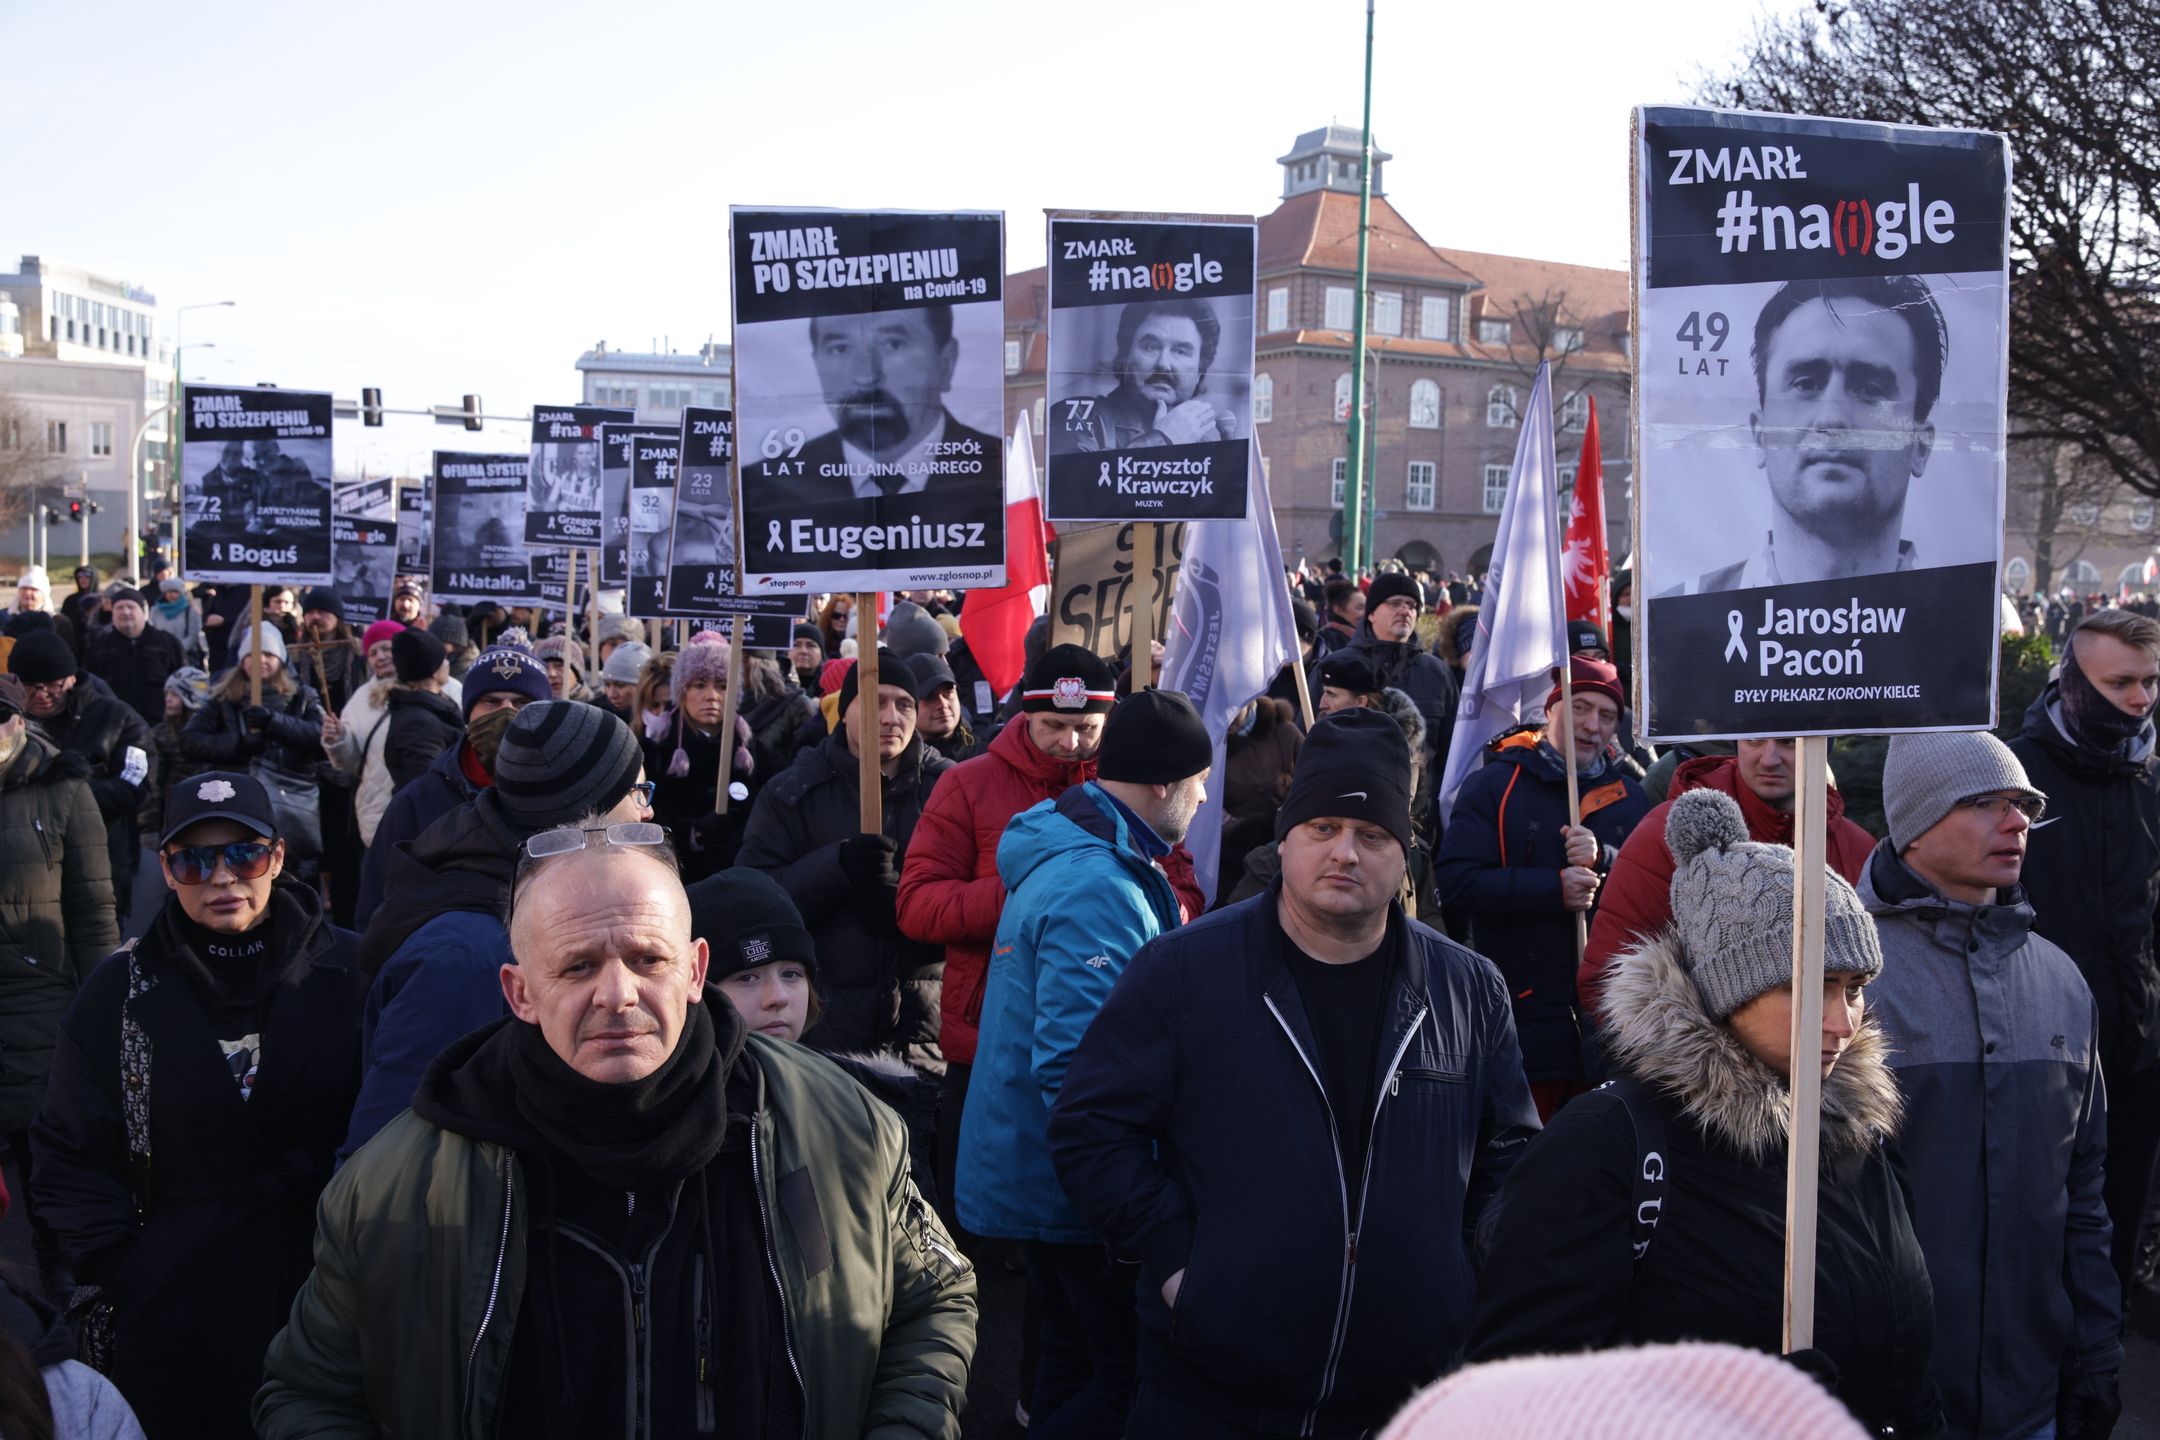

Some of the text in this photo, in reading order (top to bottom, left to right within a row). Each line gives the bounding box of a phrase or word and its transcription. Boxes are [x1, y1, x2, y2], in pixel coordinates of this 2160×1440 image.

[1667, 144, 1808, 186] ZMARŁ
[1715, 182, 1956, 260] #na(i)gle
[749, 226, 840, 262] ZMARŁ
[1063, 237, 1137, 260] ZMARŁ
[752, 247, 960, 295] PO SZCZEPIENIU
[1088, 253, 1224, 293] #na(i)gle
[903, 277, 987, 301] na Covid-19
[1675, 311, 1731, 352] 49
[1678, 357, 1730, 376] LAT
[193, 396, 243, 412] ZMARŁ
[1065, 400, 1095, 421] 77
[194, 410, 310, 429] PO SZCZEPIENIU
[538, 412, 576, 423] ZMARŁ
[289, 426, 326, 437] Covid-19
[1065, 422, 1095, 431] LAT
[760, 428, 806, 459] 69
[924, 439, 983, 457] ZESPÓŁ
[640, 448, 678, 460] ZMAR
[441, 463, 486, 479] OFIARA
[762, 462, 806, 477] LAT
[819, 459, 983, 478] GUILLAINA BARREGO
[1117, 456, 1212, 479] Krzysztof
[691, 473, 713, 488] 23
[1117, 475, 1213, 498] Krawczyk
[197, 497, 221, 514] 72
[642, 496, 660, 507] 32
[1135, 499, 1163, 508] MUZYK
[256, 506, 321, 517] ZATRZYMANIE
[275, 517, 322, 527] KRĄŻENIA
[563, 525, 594, 536] Olech
[612, 517, 628, 529] 19
[791, 515, 986, 559] Eugeniusz
[229, 543, 298, 567] Boguś
[460, 573, 526, 590] Natalka
[770, 579, 806, 588] stopnop
[909, 569, 993, 584] www.zglosnop.pl
[1757, 597, 1907, 636] Jarosław
[1759, 638, 1864, 677] Pacoń
[1734, 684, 1921, 703] BYŁY PIŁKARZ KORONY KIELCE
[208, 940, 264, 957] COLLAR
[746, 944, 768, 956] CHIC
[751, 954, 768, 962] AMOUR
[1086, 955, 1110, 968] 4F
[2050, 1035, 2065, 1049] 4F
